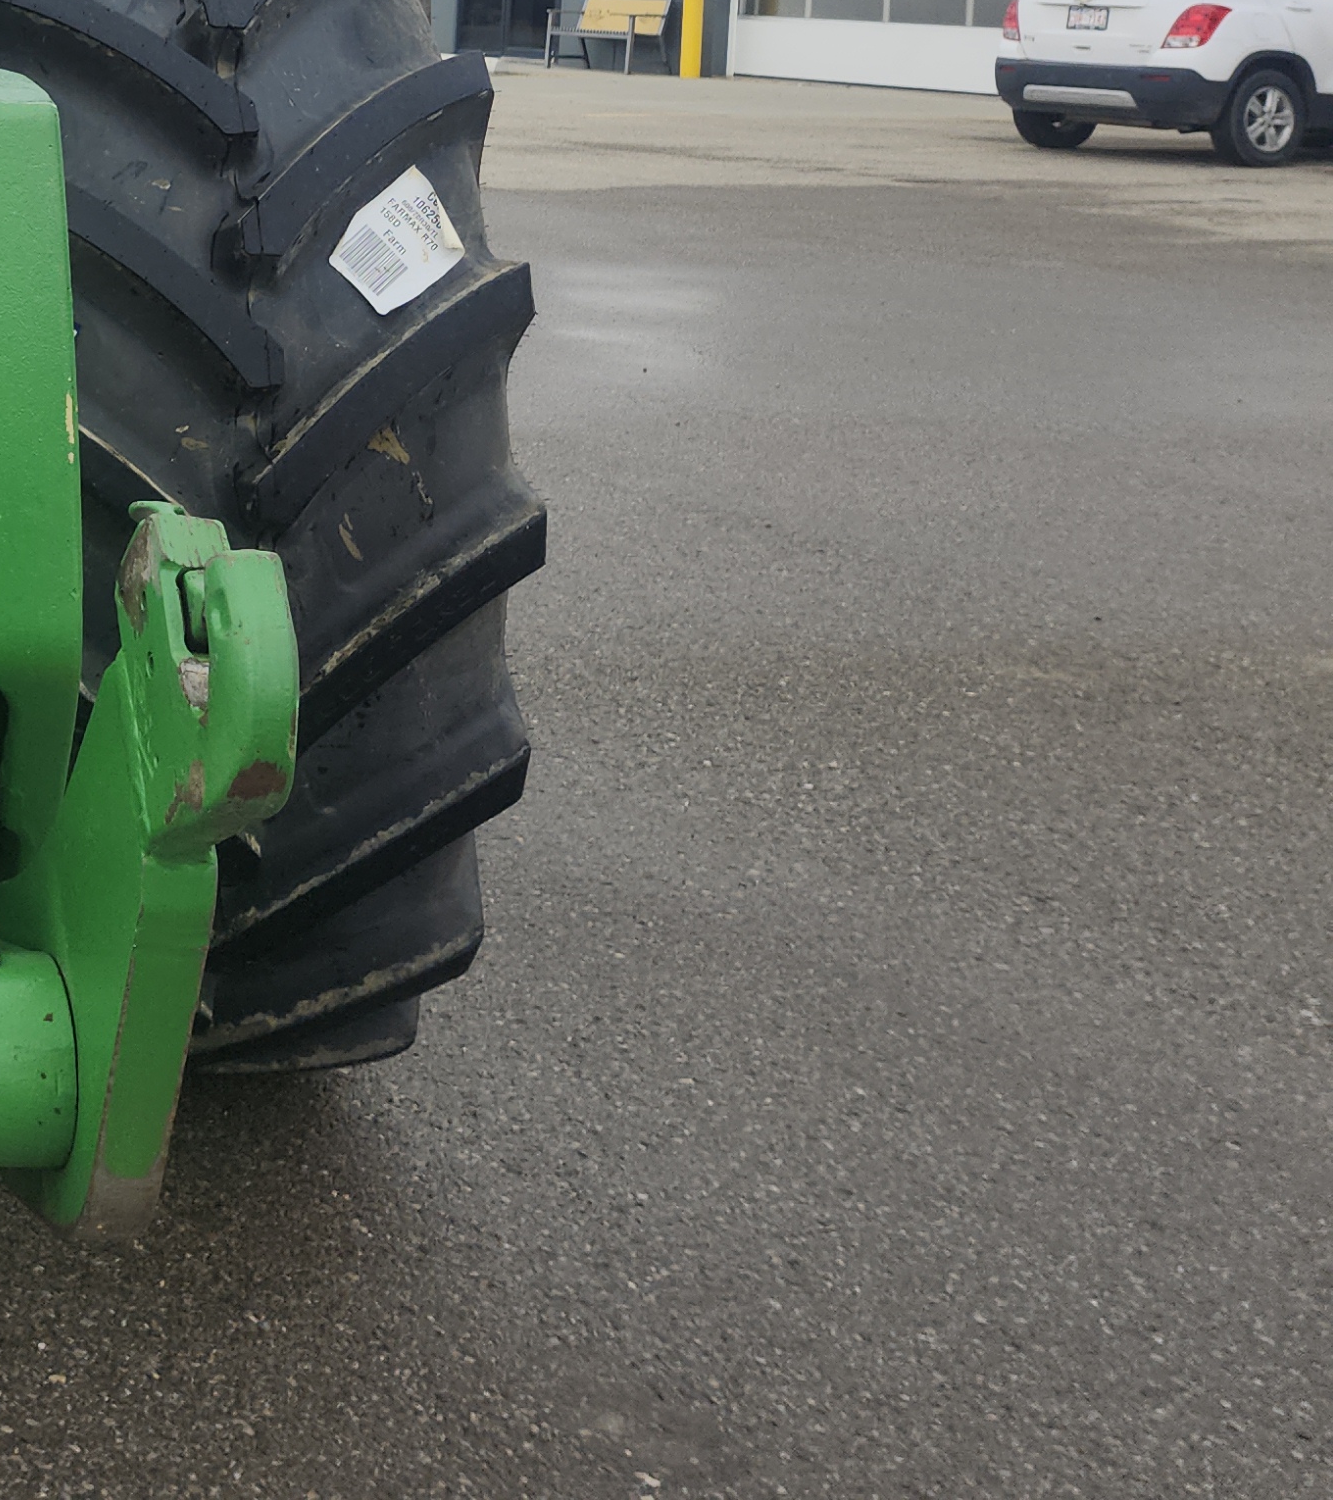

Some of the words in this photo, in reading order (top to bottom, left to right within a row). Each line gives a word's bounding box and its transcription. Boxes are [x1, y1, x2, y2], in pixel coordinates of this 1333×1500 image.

[383, 229, 407, 256] Farm
[387, 198, 422, 234] FARMAX
[422, 233, 439, 251] R70
